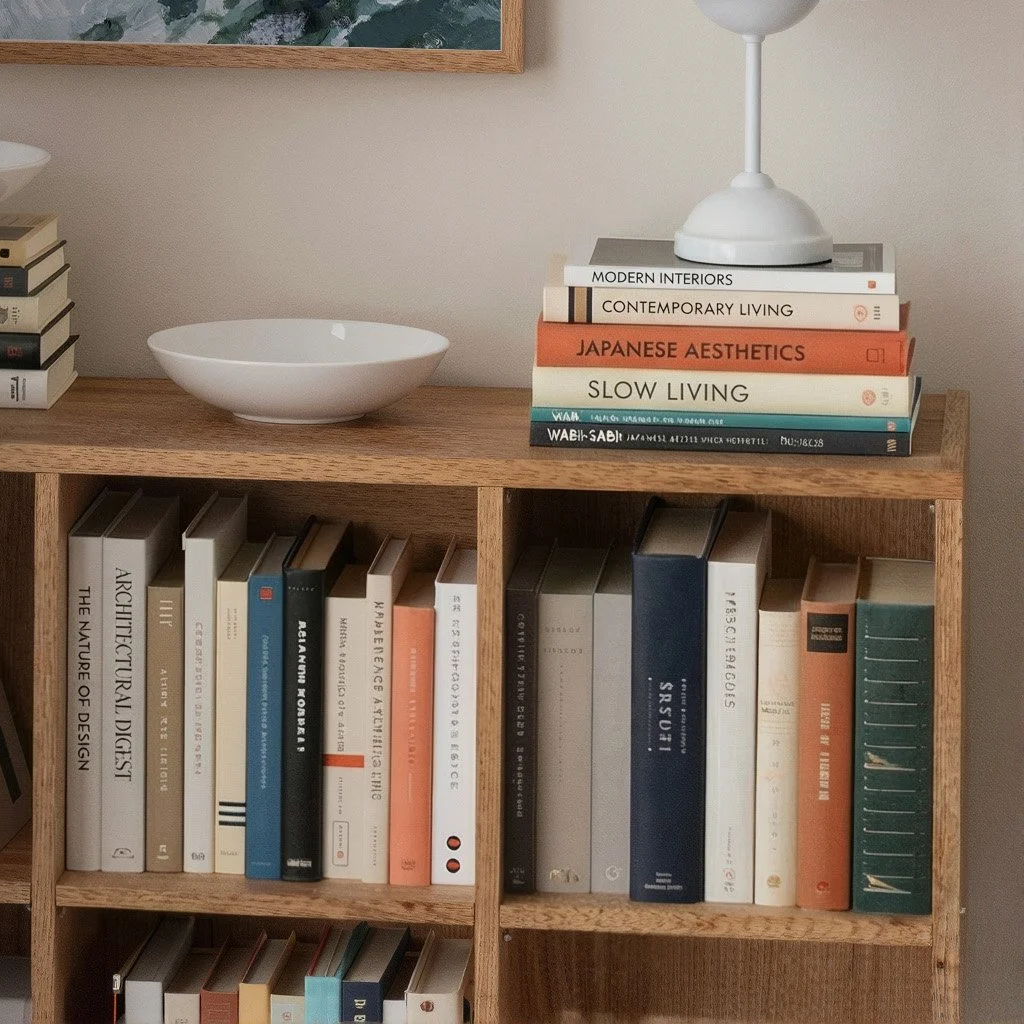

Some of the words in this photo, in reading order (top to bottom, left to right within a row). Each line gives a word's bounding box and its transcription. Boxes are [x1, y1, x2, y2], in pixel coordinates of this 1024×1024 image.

[591, 271, 655, 284] MODERN
[659, 272, 733, 286] INTERIORS
[602, 300, 734, 316] CONTEMPORARY
[739, 302, 794, 317] LIVING
[576, 339, 677, 358] JAPANESE
[684, 343, 805, 362] AESTHETICS
[587, 379, 658, 400] SLOW
[667, 382, 749, 403] LIVING
[78, 585, 91, 616] THE
[78, 620, 92, 681] NATURE
[114, 567, 133, 715] ARCHITECTURAL
[77, 685, 91, 707] OF
[77, 712, 91, 771] DESIGN
[114, 719, 133, 782] DIGEST
